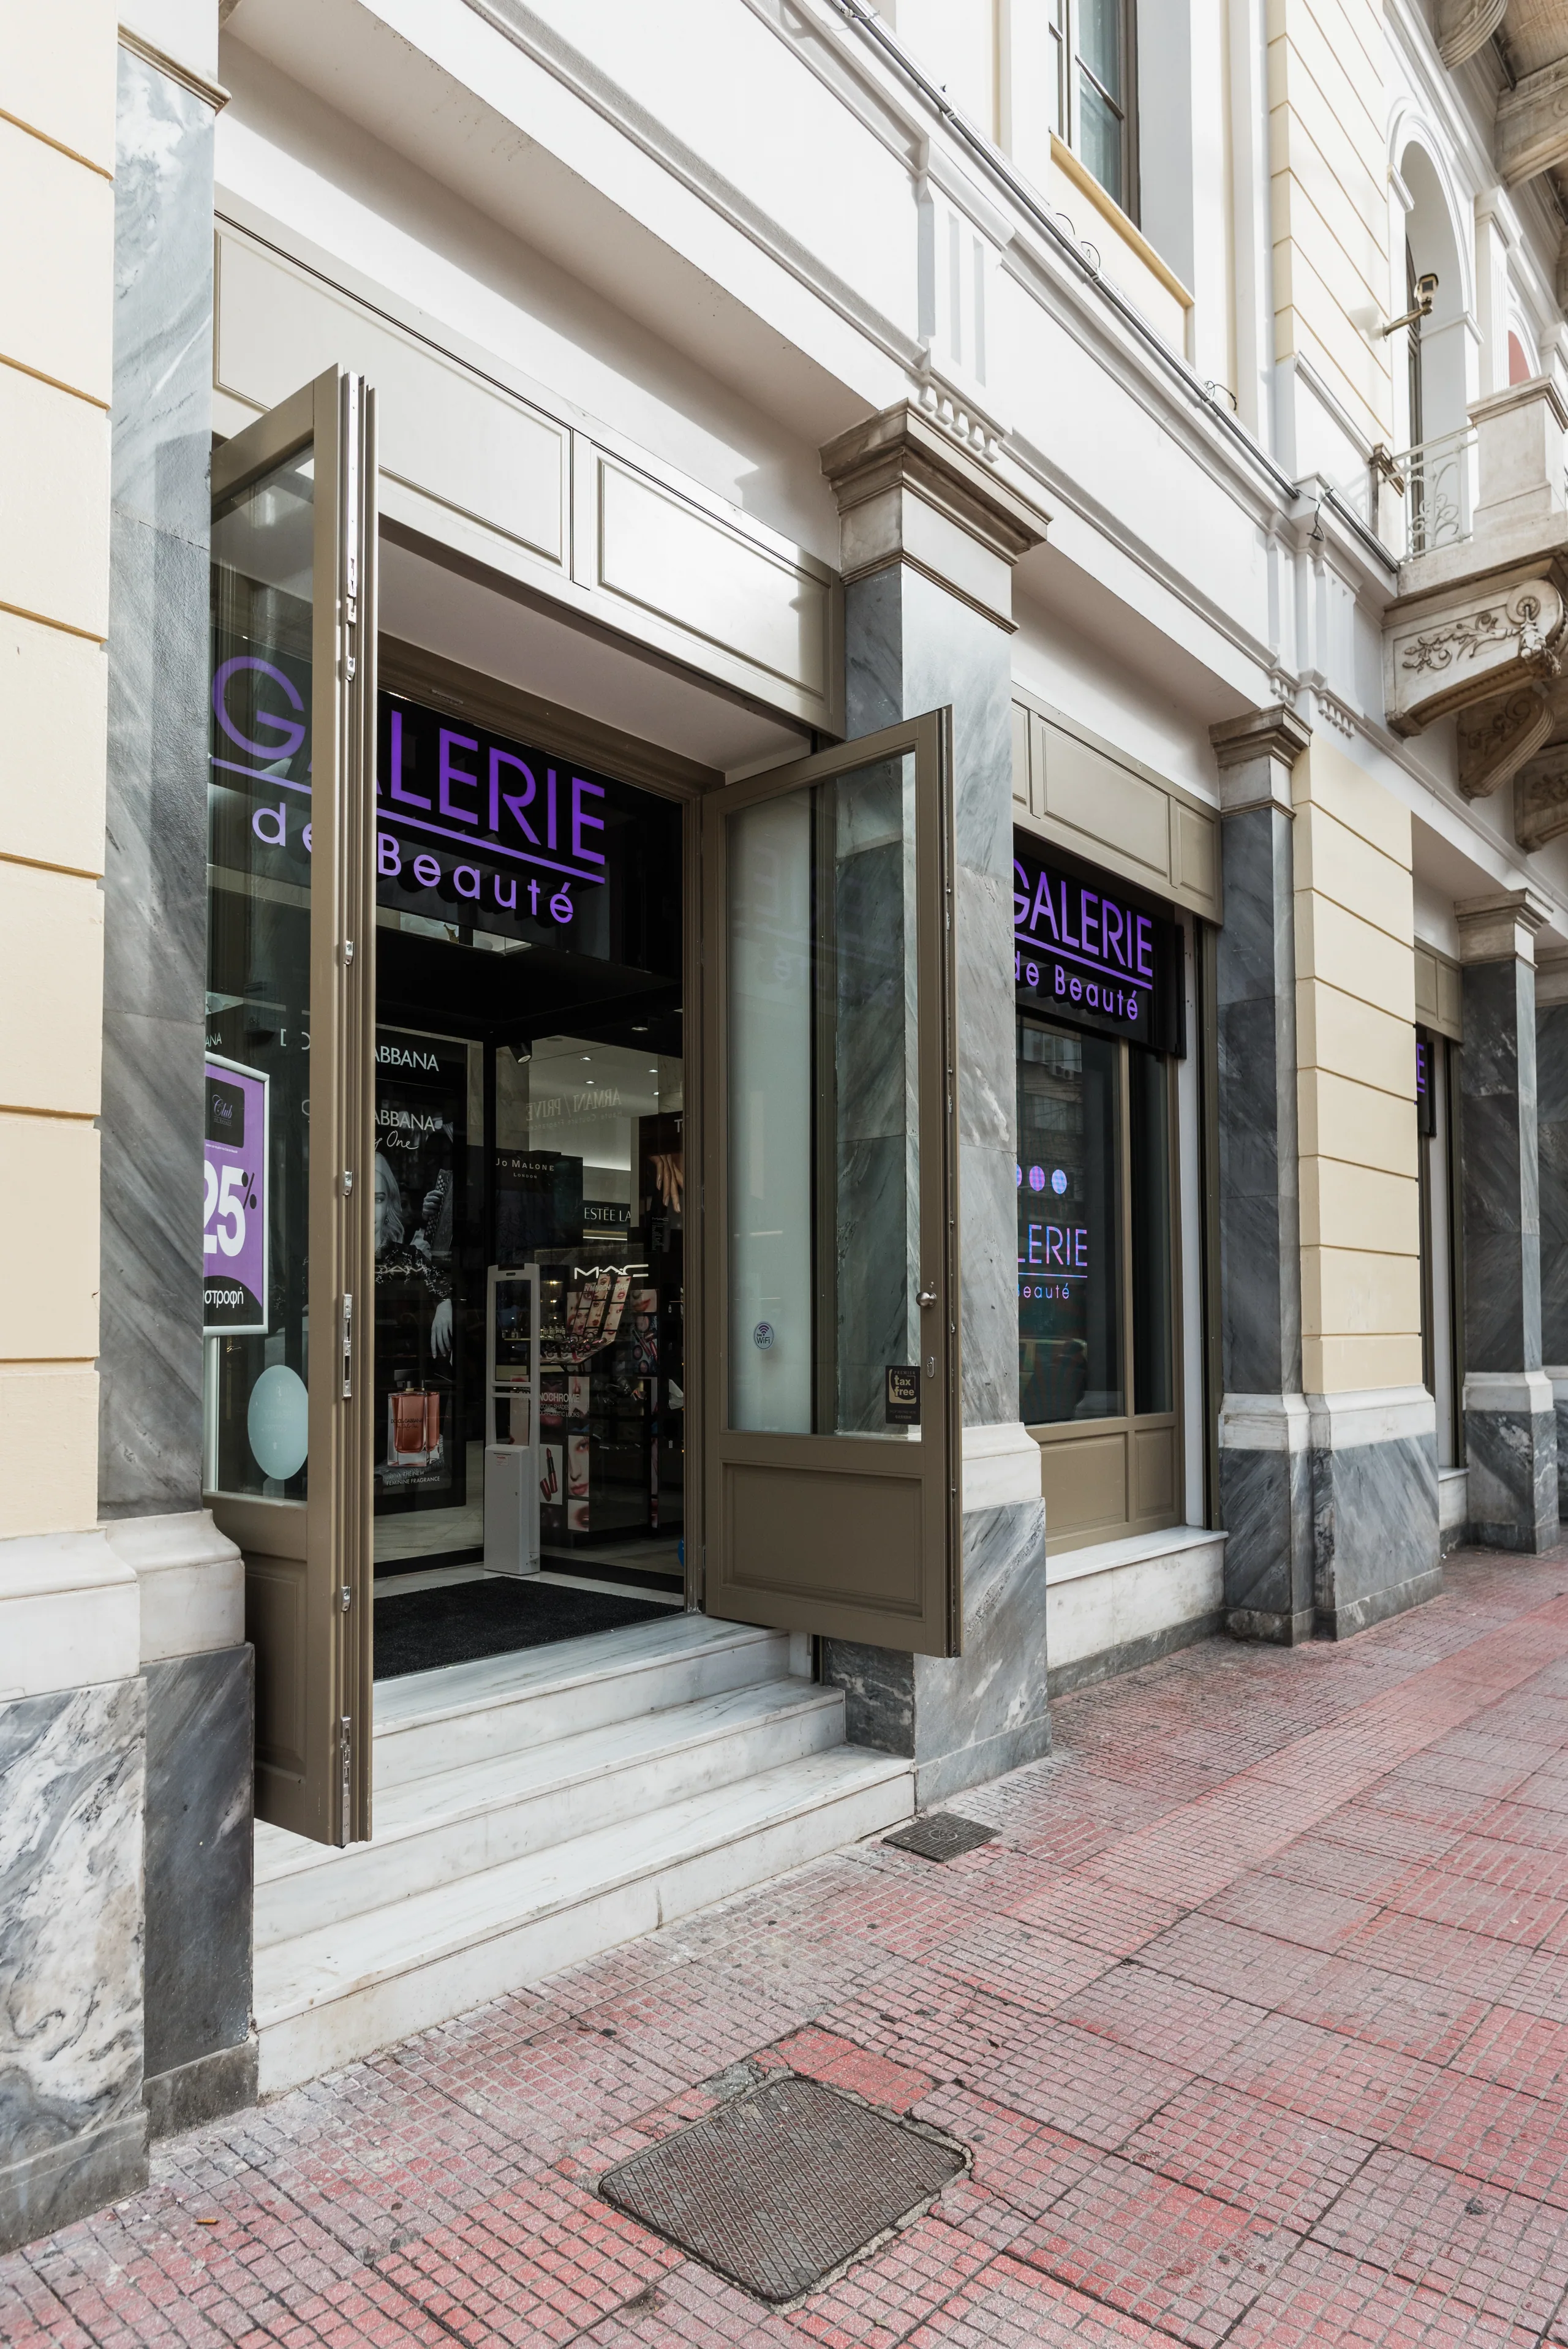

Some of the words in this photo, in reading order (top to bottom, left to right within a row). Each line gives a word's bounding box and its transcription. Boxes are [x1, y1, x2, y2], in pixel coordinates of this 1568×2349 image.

[212, 655, 606, 865] GLERIE
[252, 803, 311, 854] d
[378, 834, 574, 923] Beauté
[1055, 965, 1138, 1020] Beauté
[213, 1095, 232, 1118] Club
[386, 1130, 419, 1150] One
[1017, 1283, 1070, 1299] eauté
[894, 1374, 911, 1386] tax
[894, 1386, 915, 1397] free
[411, 1476, 440, 1484] FRAGRANCE
